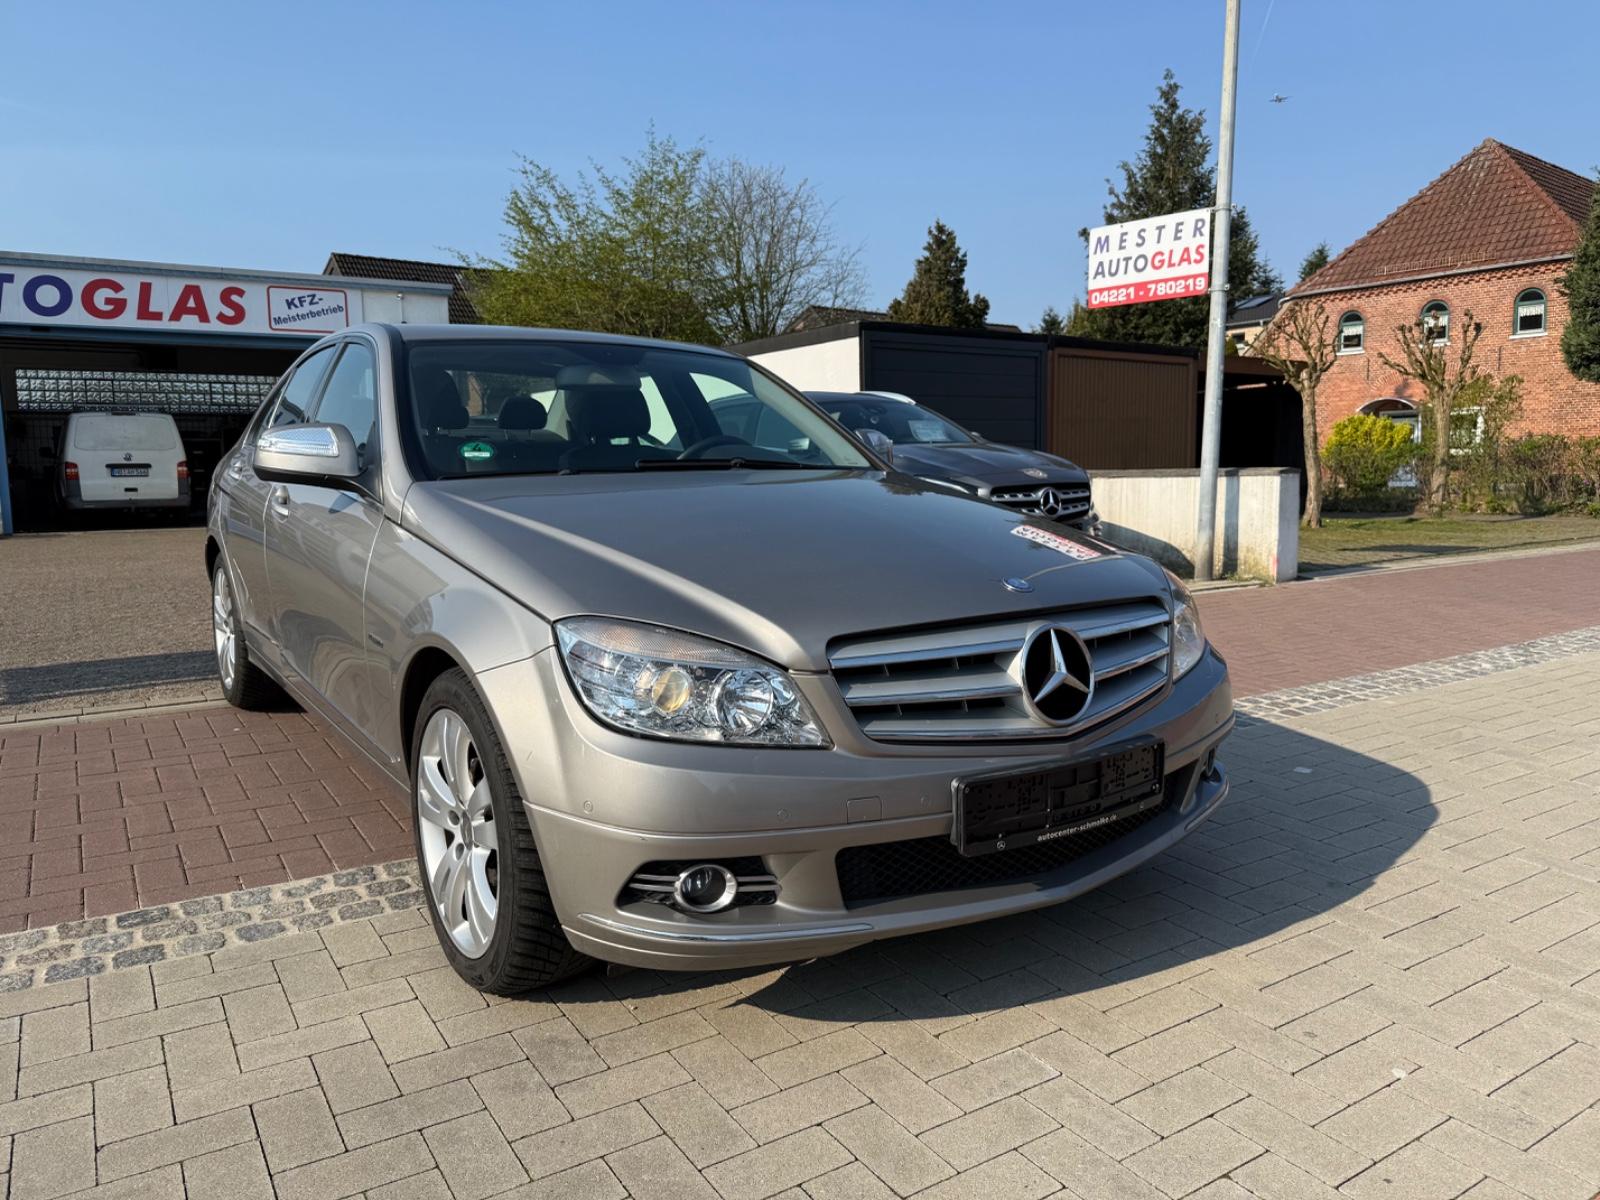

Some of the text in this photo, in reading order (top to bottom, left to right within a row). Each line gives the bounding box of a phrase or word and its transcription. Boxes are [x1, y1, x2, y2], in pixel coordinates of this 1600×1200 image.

[1093, 218, 1206, 255] MESTER
[1092, 244, 1206, 280] AUTOGLAS
[285, 293, 324, 310] KFZ-
[1091, 286, 1135, 305] 04221
[1147, 277, 1206, 297] 780219
[273, 304, 344, 325] Meisterbetrieb
